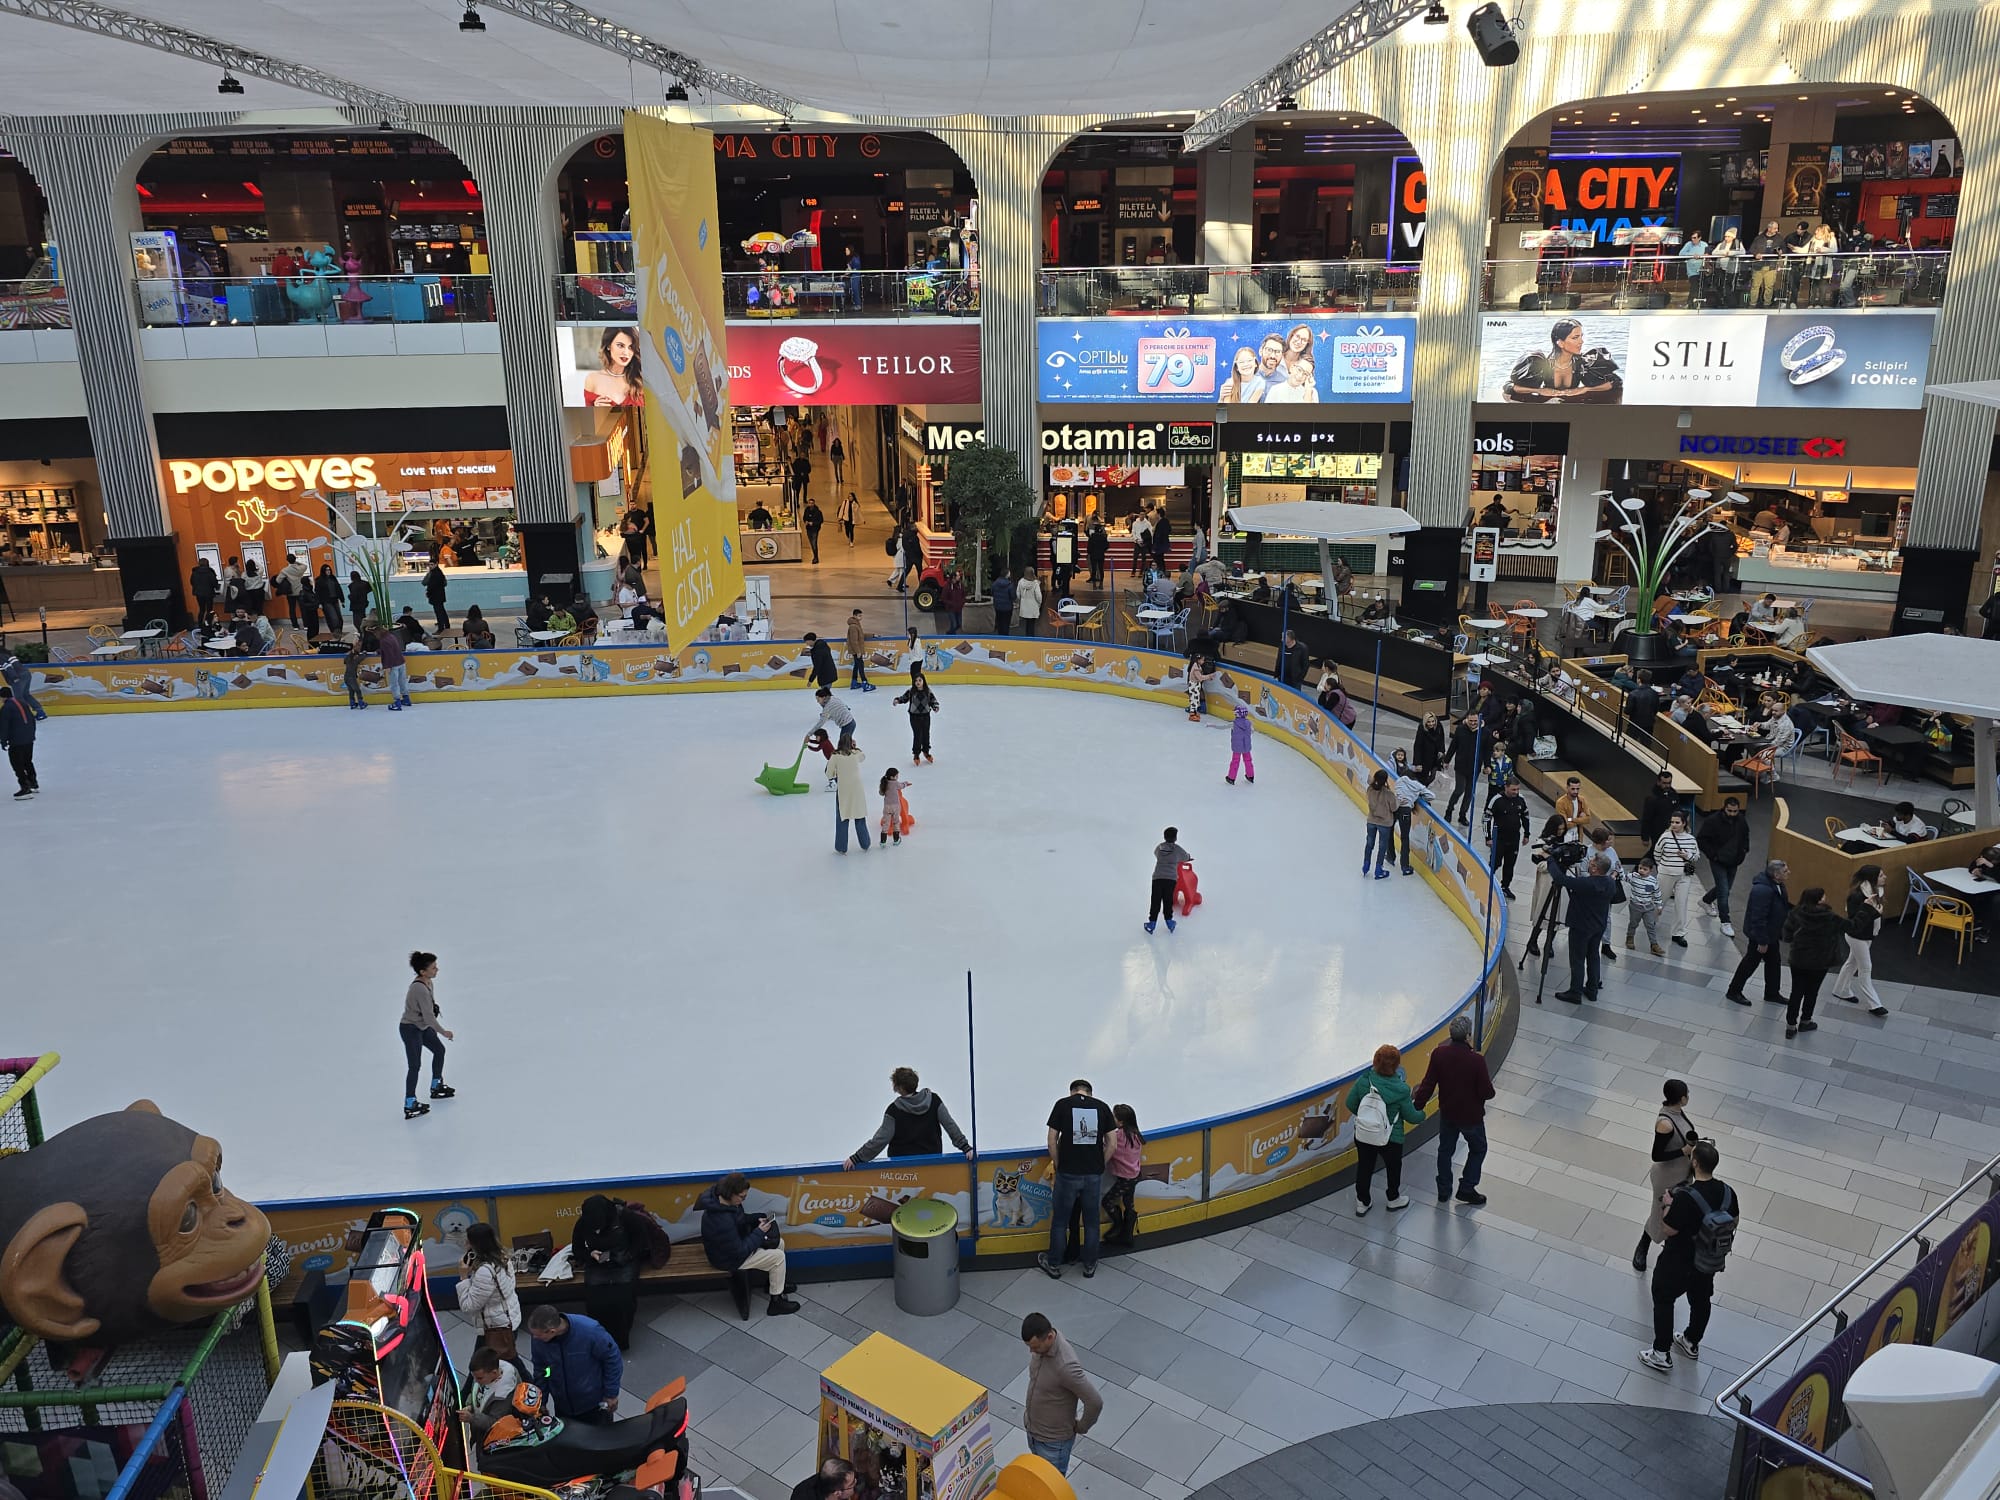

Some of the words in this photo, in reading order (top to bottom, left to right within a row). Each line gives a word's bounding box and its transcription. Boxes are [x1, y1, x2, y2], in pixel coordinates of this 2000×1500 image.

[772, 135, 838, 158] CITY
[1579, 167, 1674, 209] CITY
[1120, 203, 1144, 211] BILETE
[1341, 342, 1396, 356] BRANDS
[1653, 341, 1734, 368] STIL
[1079, 350, 1128, 364] OPTIblu
[858, 356, 954, 375] TEILOR
[1144, 353, 1195, 388] 79
[1351, 358, 1387, 371] SALE
[1864, 361, 1908, 372] Sclipiri
[1651, 374, 1732, 382] DIAMONDS
[1851, 374, 1917, 386] ICONice
[1257, 434, 1301, 442] SALAD
[1311, 434, 1334, 442] BOX
[1680, 435, 1798, 456] NORDSEE
[401, 467, 426, 476] LOVE
[429, 466, 453, 475] THAT
[457, 465, 496, 475] CHICKEN
[1392, 557, 1405, 565] Sn
